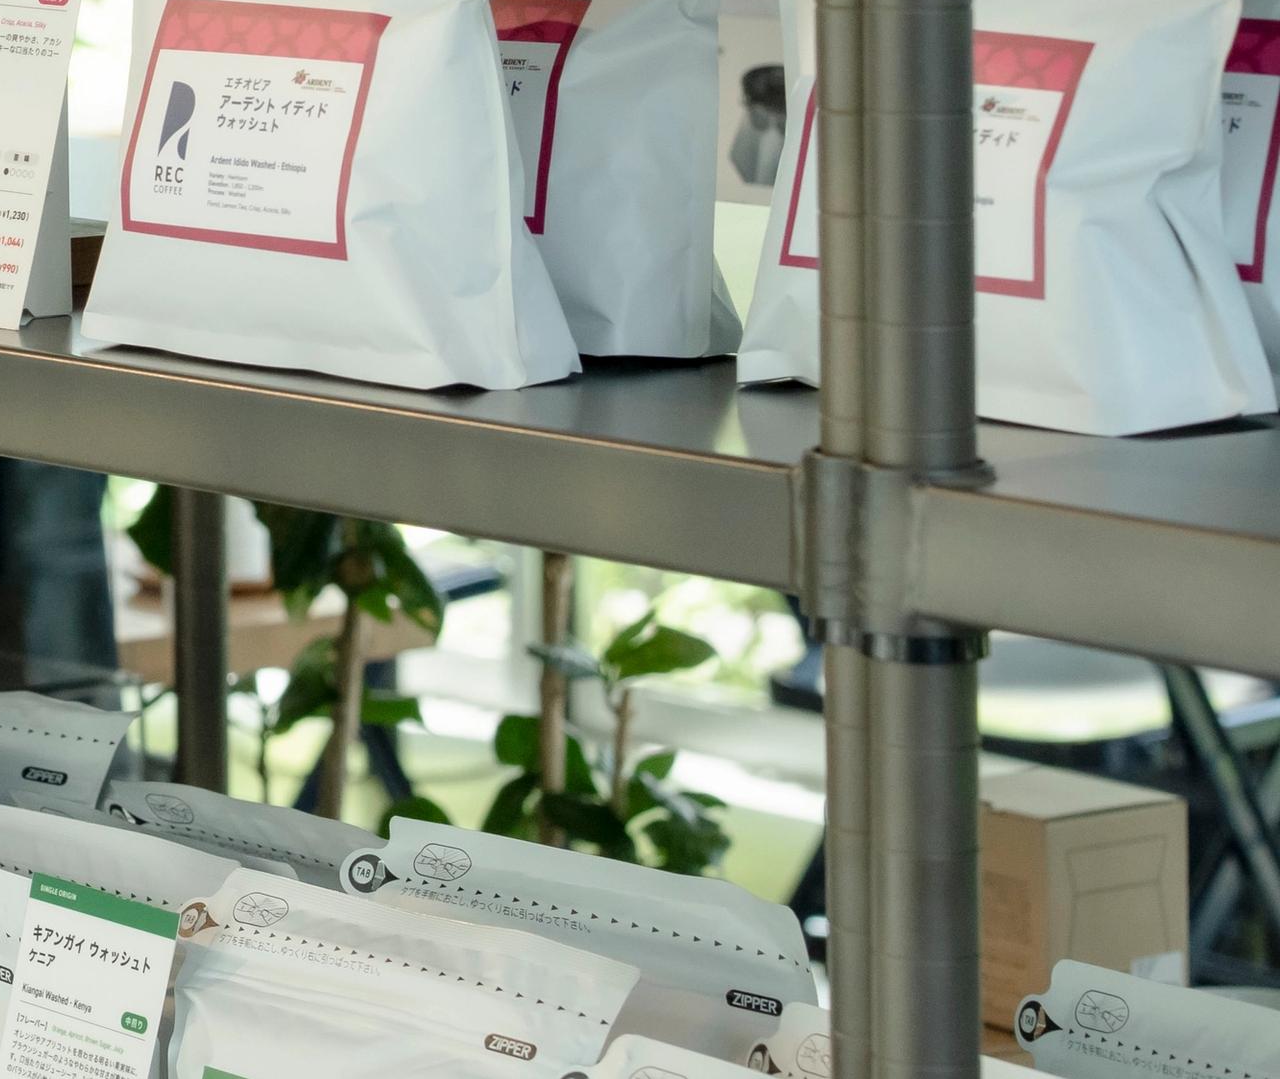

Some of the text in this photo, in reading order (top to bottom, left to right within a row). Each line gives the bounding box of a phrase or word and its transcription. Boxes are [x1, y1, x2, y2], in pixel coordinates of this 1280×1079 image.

[224, 77, 271, 92] エチオピア
[220, 95, 328, 118] アーデント イディド
[216, 114, 279, 133] ウォッシュト
[155, 166, 184, 183] REC
[153, 184, 183, 196] COFFEE
[26, 768, 65, 784] ZIPPER
[356, 867, 371, 879] TAB
[40, 884, 77, 901] SINGLE ORIGIN
[29, 949, 56, 967] ケニア
[33, 925, 151, 974] キアンガイ ウォッシュト
[22, 983, 92, 1013] Kiangai Washed Kenya
[731, 992, 778, 1015] ZIPPER
[489, 1036, 532, 1059] ZIPPER
